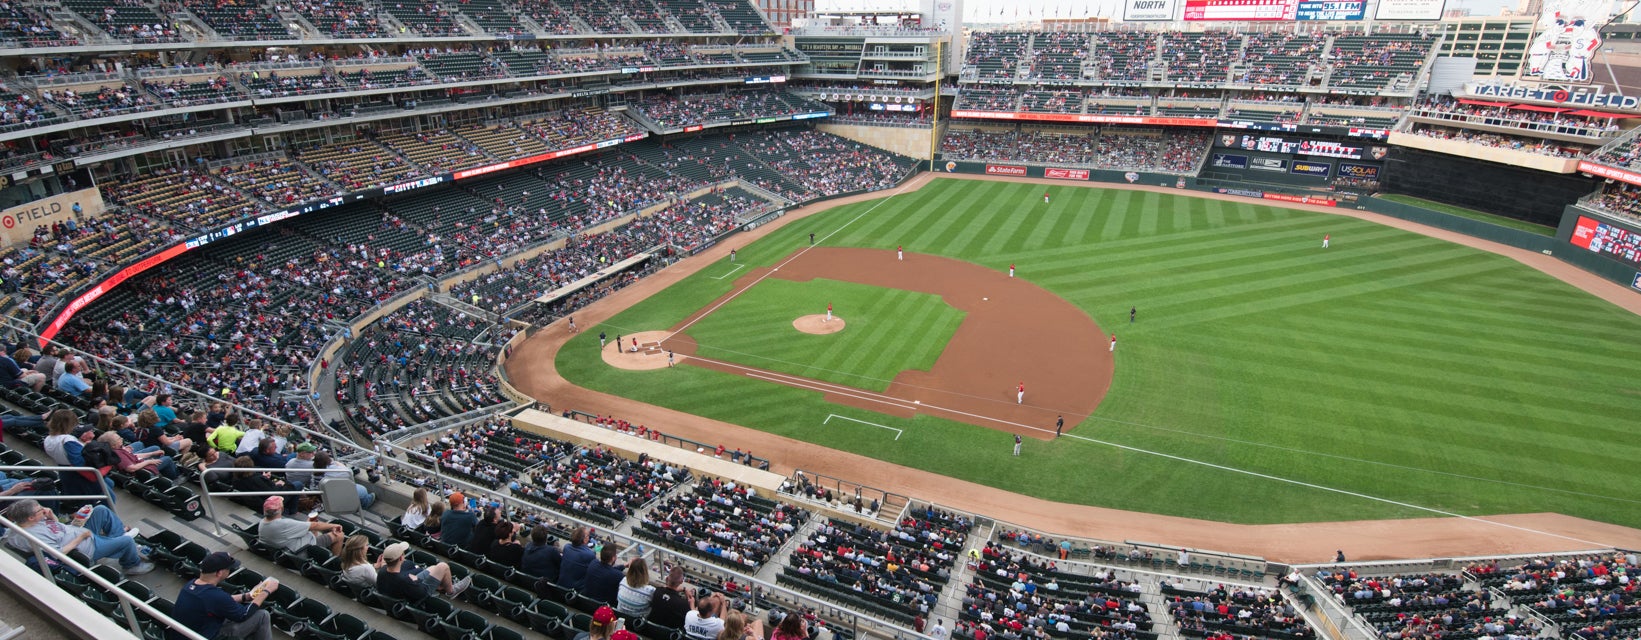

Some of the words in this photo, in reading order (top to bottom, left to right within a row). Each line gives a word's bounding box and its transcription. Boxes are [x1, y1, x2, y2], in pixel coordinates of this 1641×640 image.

[1133, 1, 1167, 9] NORTH
[1474, 84, 1553, 100] TARGET
[1571, 93, 1638, 109] FIELD
[1294, 164, 1327, 172] SUBWAY
[16, 202, 62, 224] FIELD
[132, 254, 162, 274] OUTPERFORM
